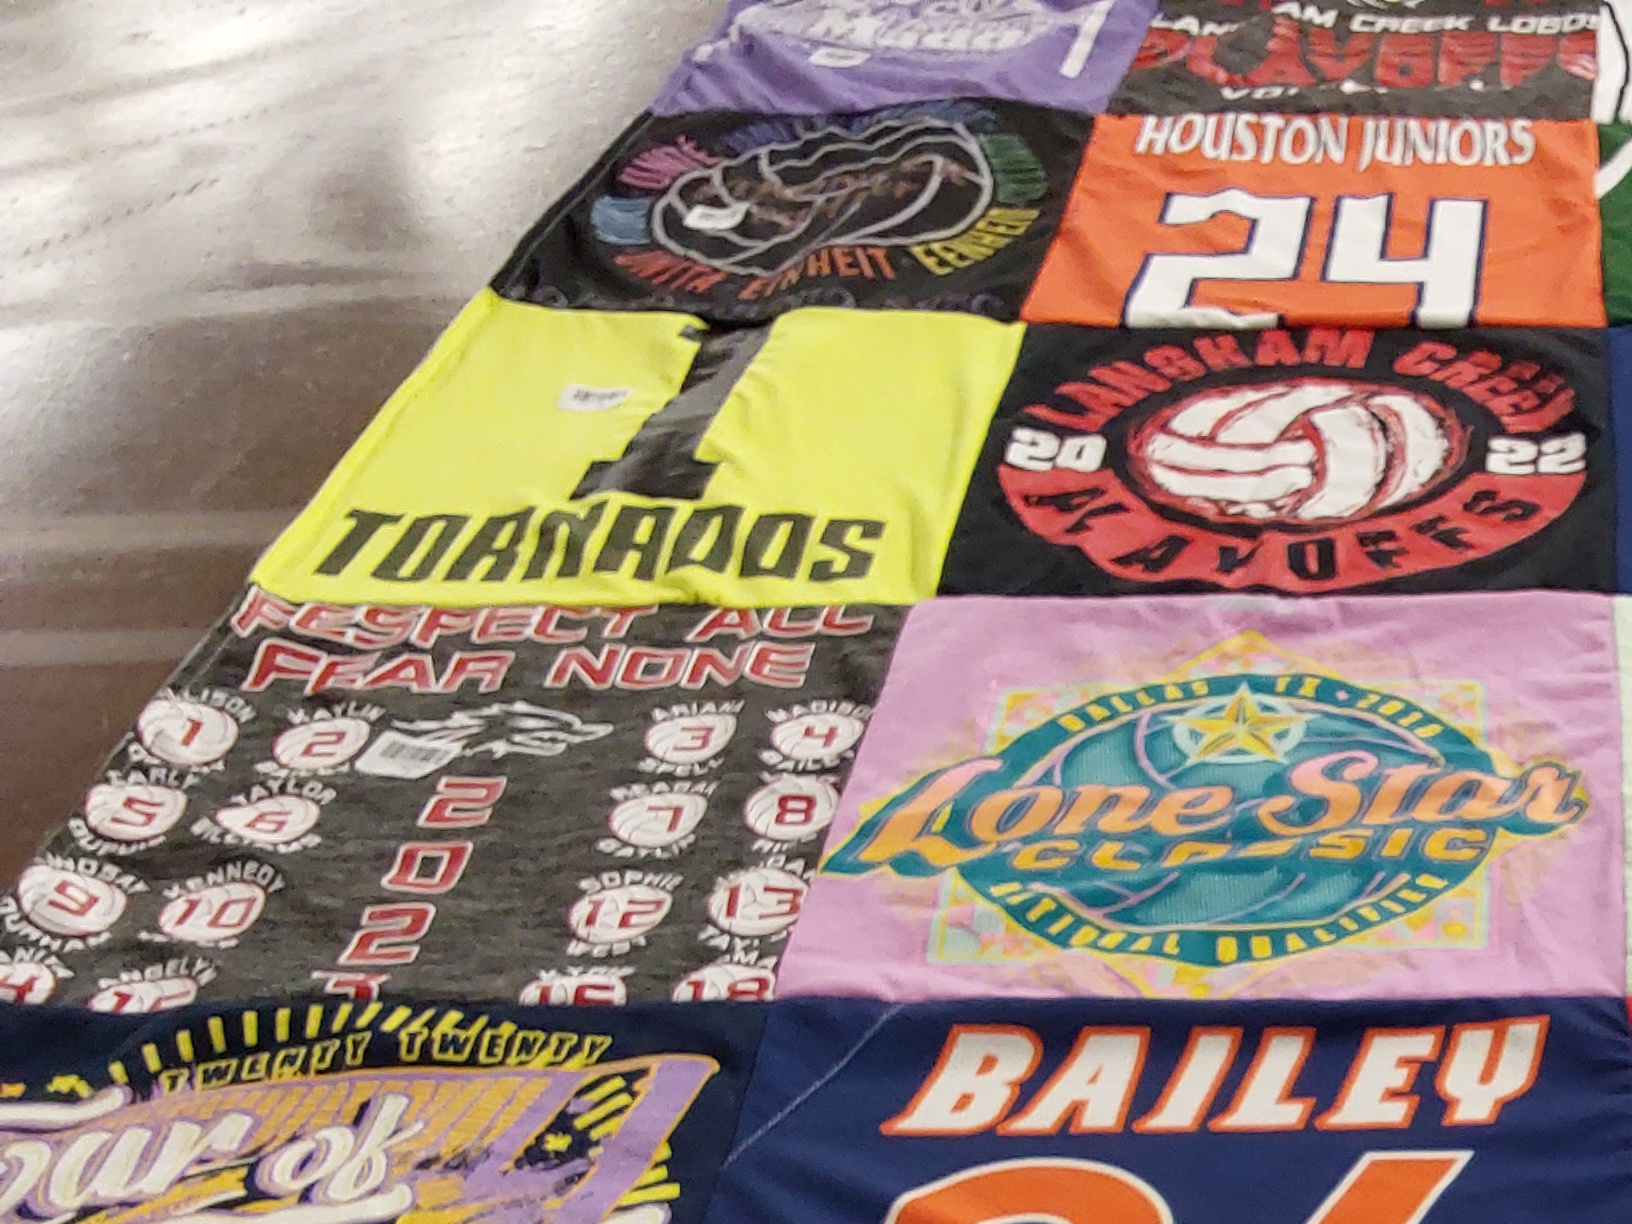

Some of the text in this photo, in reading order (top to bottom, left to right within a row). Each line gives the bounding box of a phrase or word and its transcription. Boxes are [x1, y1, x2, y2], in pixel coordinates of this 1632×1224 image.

[1134, 114, 1536, 170] HOUSTON JUNIORS
[1124, 188, 1485, 328] 24
[1025, 328, 1376, 432] LANGHAM
[1004, 428, 1588, 476] 20 22
[312, 505, 888, 584] TORNADOS
[686, 604, 873, 641] ALL
[240, 637, 817, 695] FEAR NONE
[803, 725, 839, 748] 4
[111, 796, 166, 827] 5
[774, 794, 818, 827] 8
[862, 750, 1592, 868] Lone Star
[158, 1027, 613, 1094] TWENTY TWENTY
[879, 1015, 1551, 1137] BAILEY
